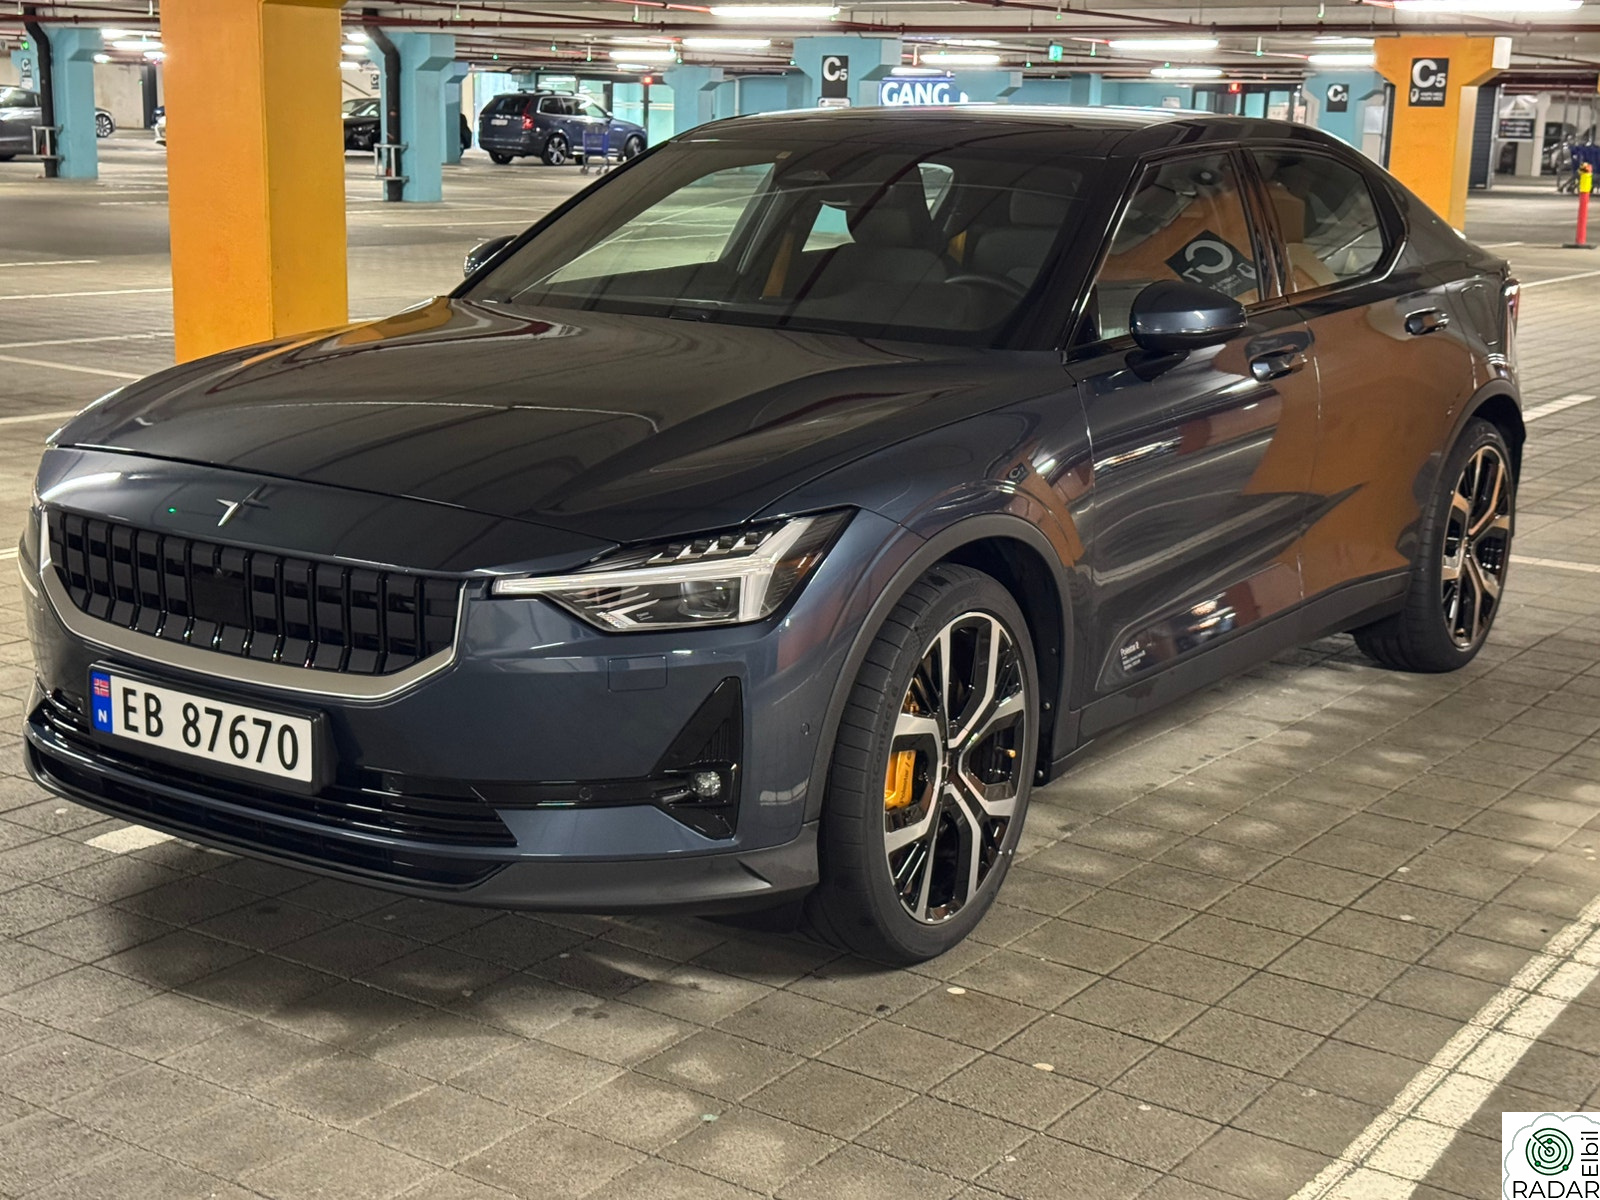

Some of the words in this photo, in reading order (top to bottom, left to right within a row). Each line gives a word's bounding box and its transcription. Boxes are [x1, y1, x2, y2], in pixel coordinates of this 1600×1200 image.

[823, 57, 848, 81] C5
[1412, 59, 1446, 88] C5
[98, 709, 107, 723] N
[122, 686, 163, 737] EB
[182, 702, 299, 771] 87670
